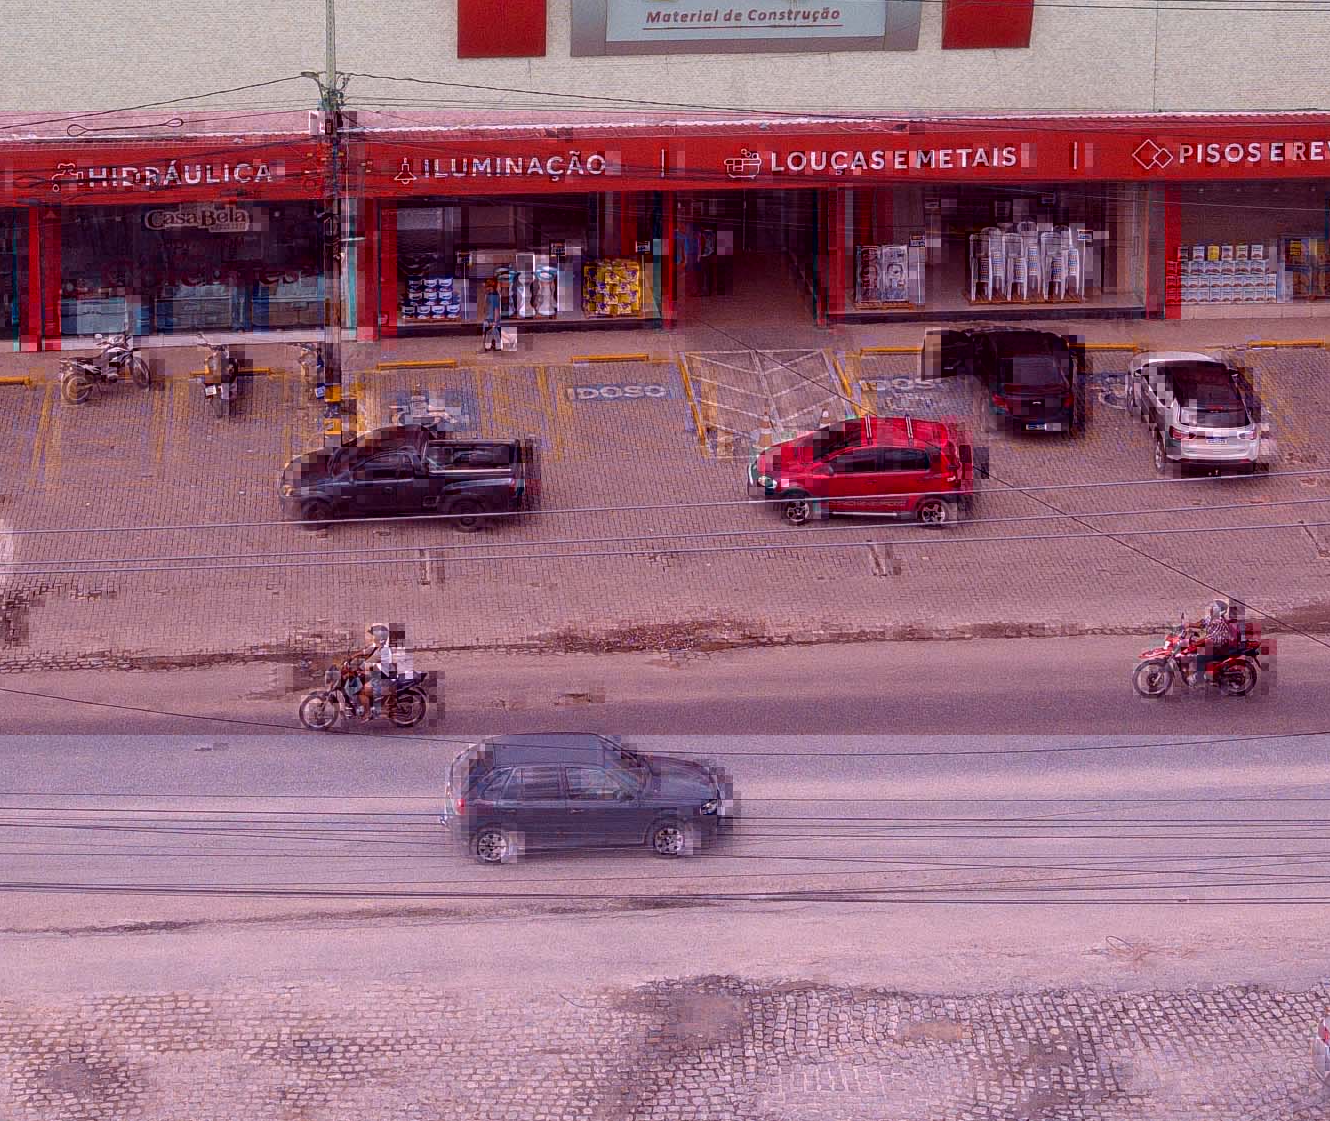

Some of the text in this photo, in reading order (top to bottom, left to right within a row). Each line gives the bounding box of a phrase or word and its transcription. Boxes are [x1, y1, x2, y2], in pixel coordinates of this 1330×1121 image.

[646, 6, 841, 24] Material de Construção
[424, 150, 606, 181] ILUMINAÇÃO
[771, 147, 1018, 175] LOUÇAS E METAIS
[1180, 142, 1263, 164] PISOS
[1270, 142, 1284, 162] E
[88, 159, 272, 186] HIDRÁULICA
